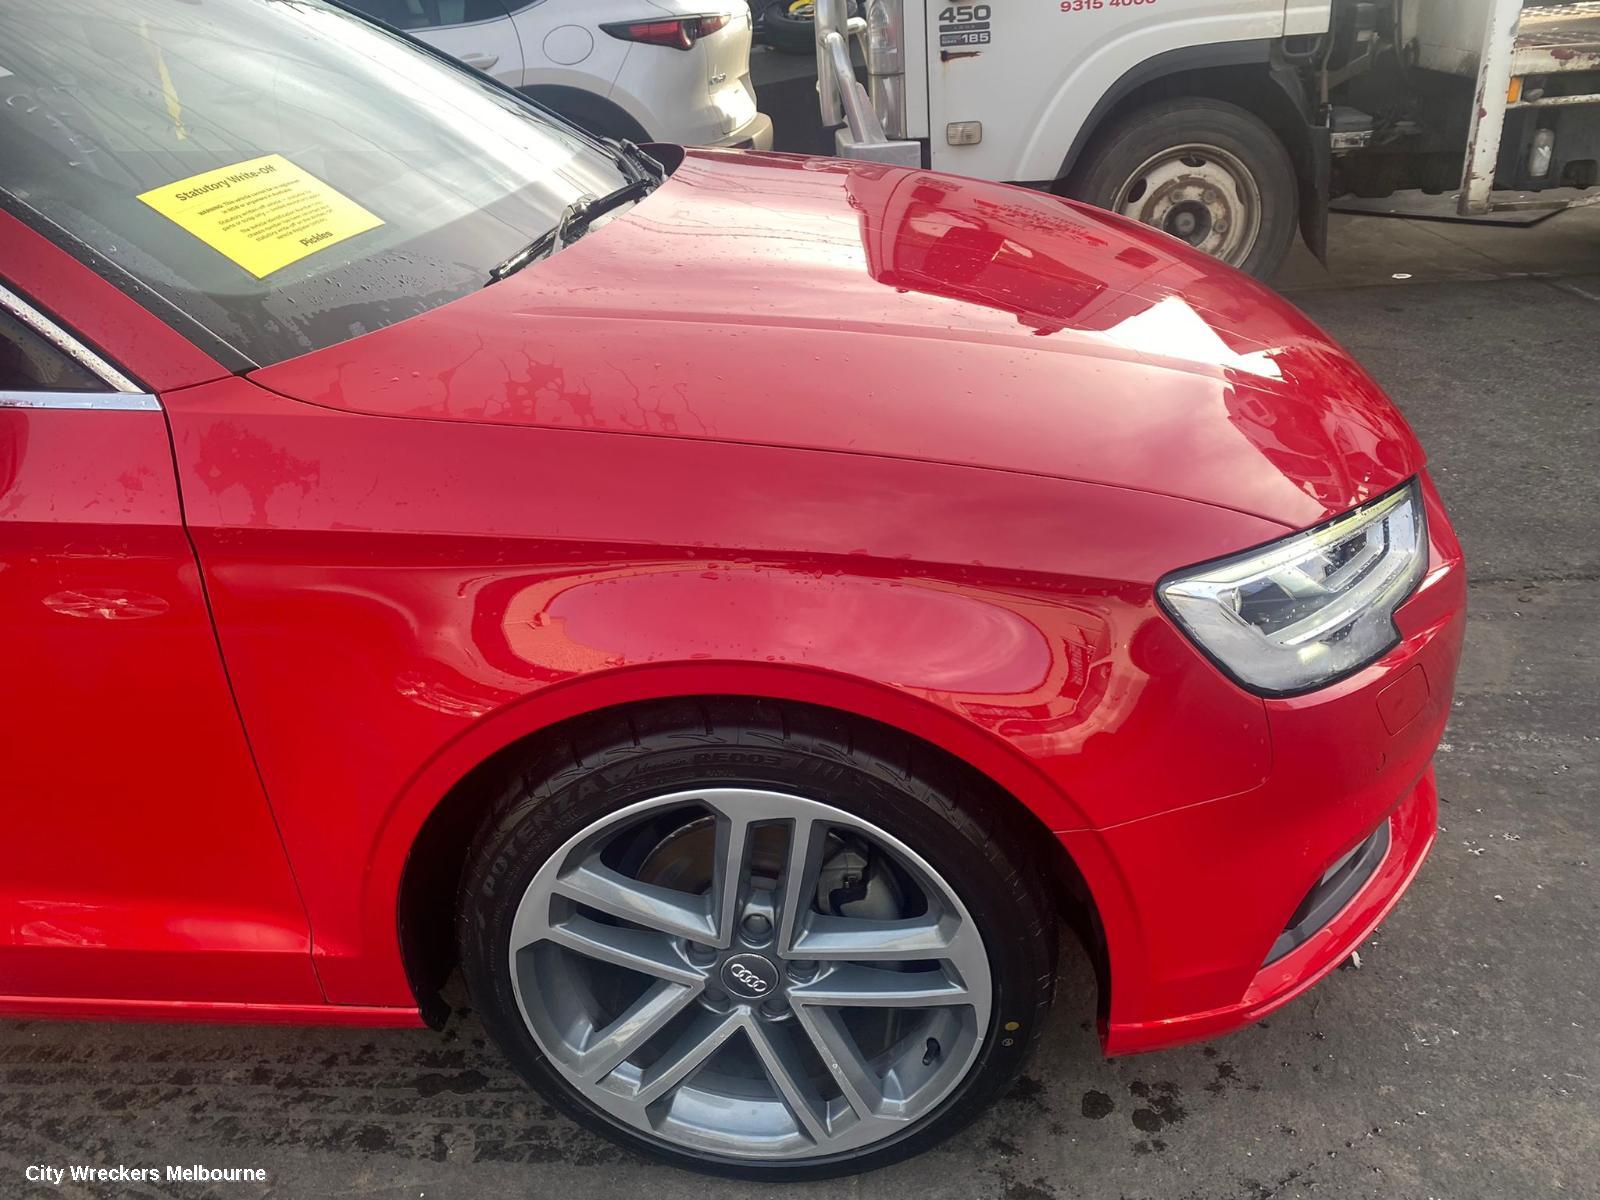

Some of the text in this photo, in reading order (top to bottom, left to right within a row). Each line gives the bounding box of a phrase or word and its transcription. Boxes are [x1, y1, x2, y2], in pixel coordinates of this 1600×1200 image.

[939, 5, 991, 23] 450
[1060, 0, 1104, 12] 9315
[961, 33, 989, 44] 185
[174, 165, 277, 202] Statutory Write-Off
[299, 230, 334, 248] Pickles
